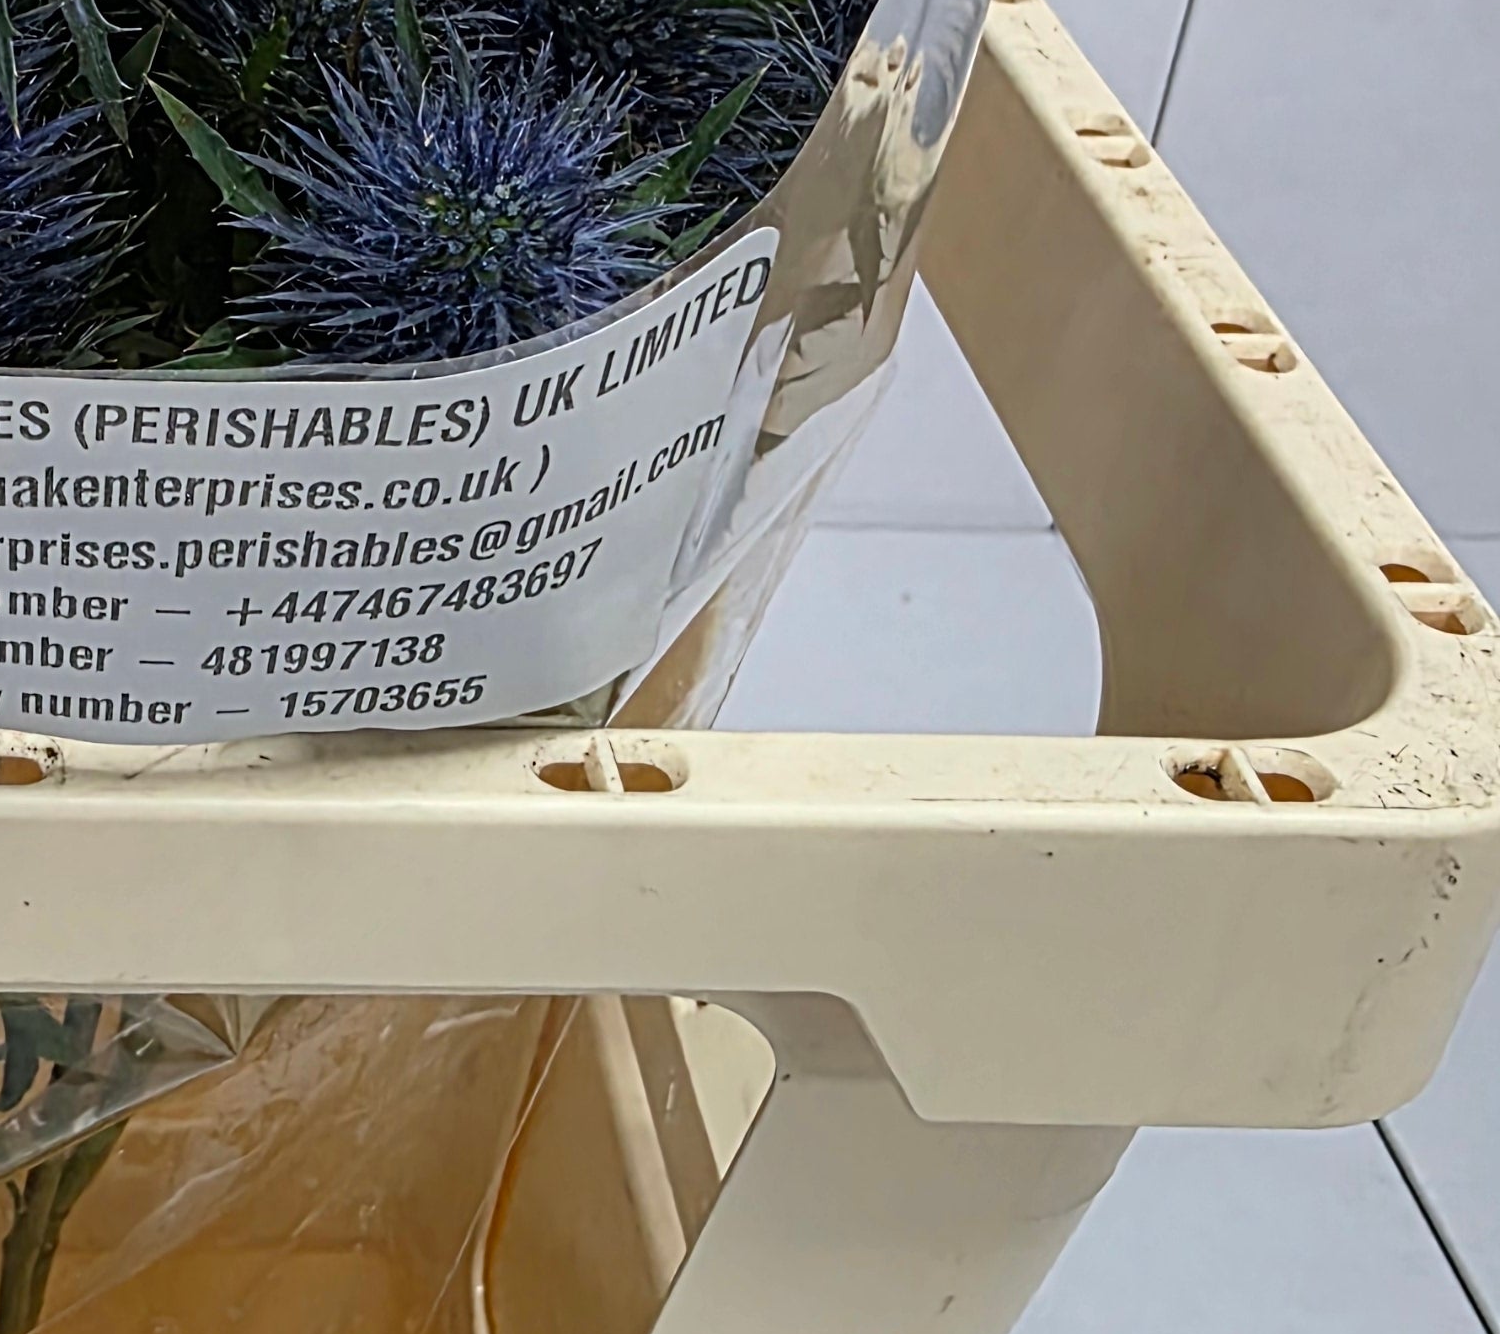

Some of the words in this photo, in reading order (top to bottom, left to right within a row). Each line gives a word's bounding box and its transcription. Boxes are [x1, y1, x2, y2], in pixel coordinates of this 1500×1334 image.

[74, 396, 491, 450] (PERISHABLES)
[514, 363, 585, 427] UK
[598, 256, 772, 397] LIMITED
[227, 538, 603, 627] +447467483697
[201, 633, 445, 677] 481997138
[20, 690, 192, 725] number
[281, 675, 487, 719] 15703655
